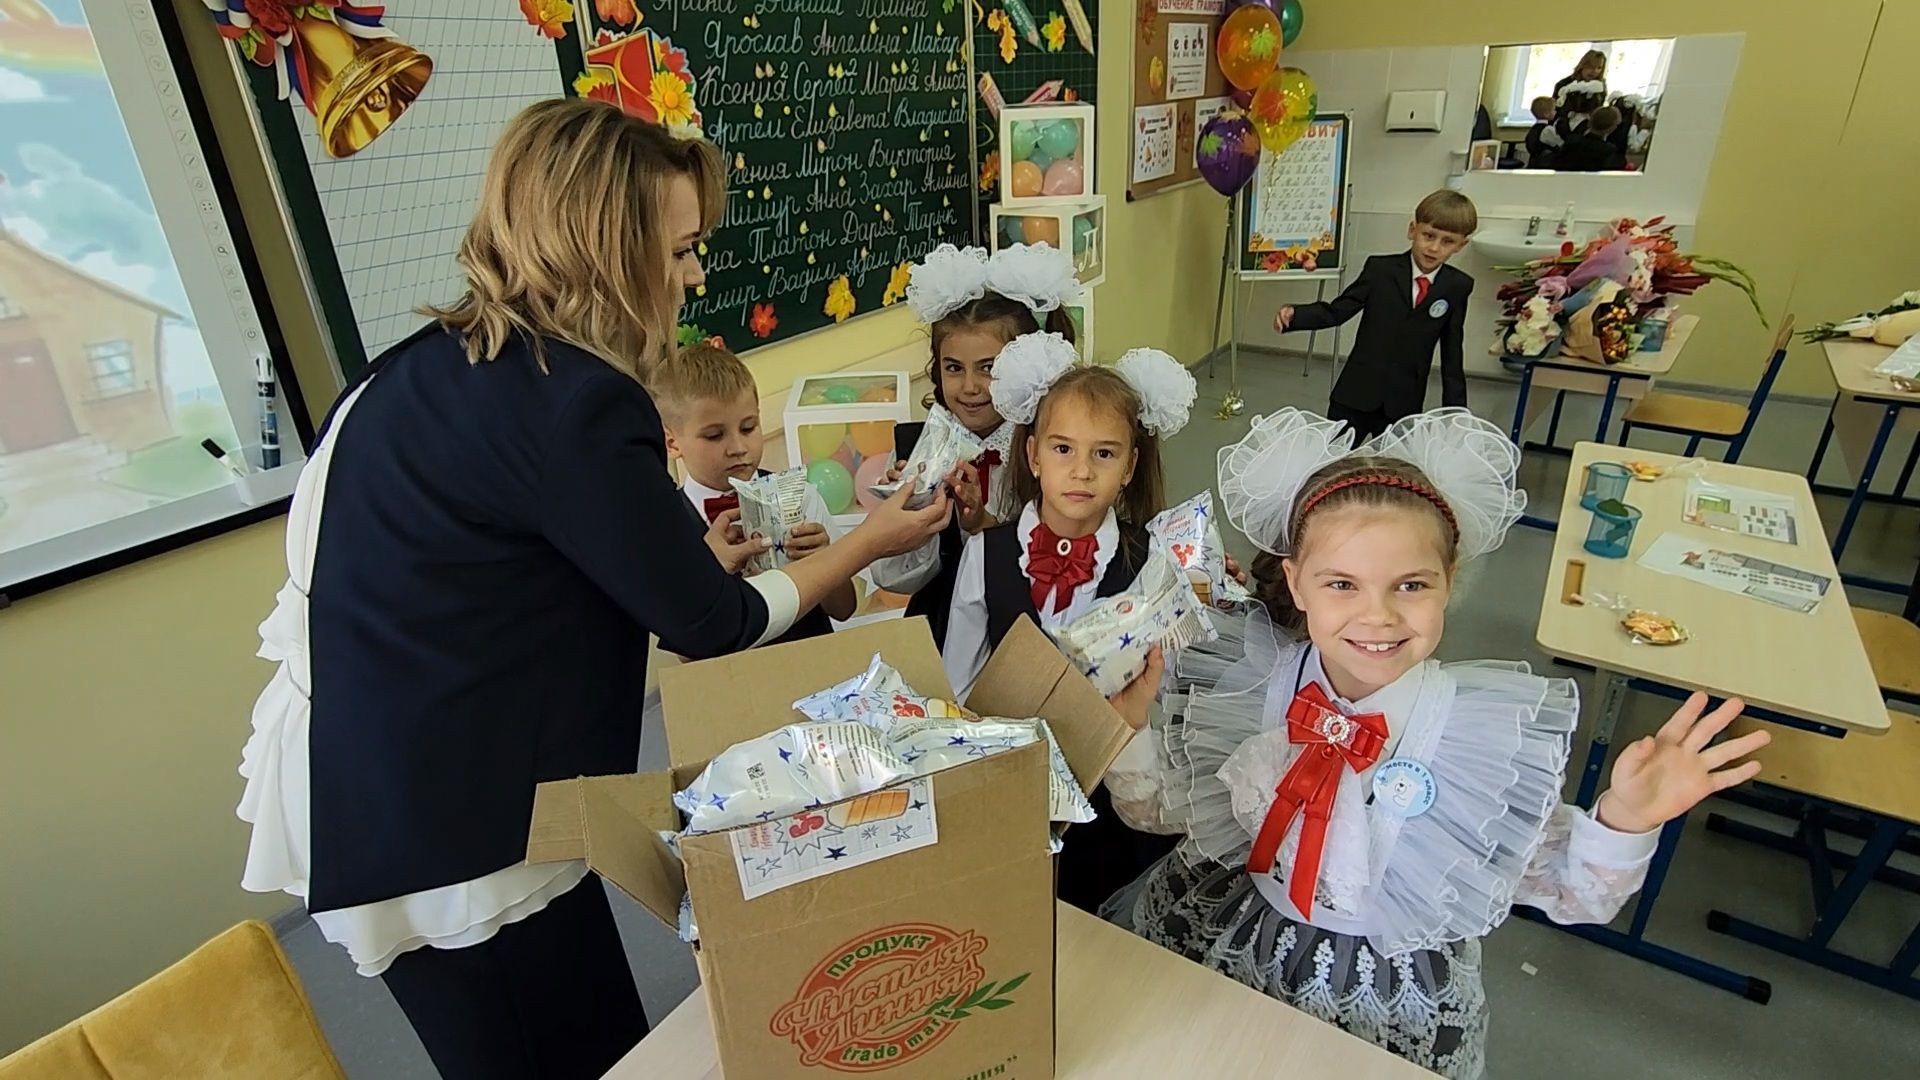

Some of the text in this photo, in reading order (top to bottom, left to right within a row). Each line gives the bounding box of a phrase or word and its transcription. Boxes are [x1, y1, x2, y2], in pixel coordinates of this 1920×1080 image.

[704, 16, 960, 81] Ярослав Ангелина Макар
[699, 65, 790, 106] Ксения
[861, 61, 919, 112] Мария
[790, 98, 890, 150] Елизавета
[893, 92, 967, 139] Владислав
[725, 139, 956, 193] вгения Мирон Виктория
[860, 170, 916, 213] Захар
[748, 227, 836, 264] Платон
[840, 210, 897, 249] Дарья
[677, 284, 761, 326] атмир
[767, 262, 839, 303] Вадим
[827, 934, 934, 977] ПРОДУКТ
[842, 1005, 955, 1062] trade mark
